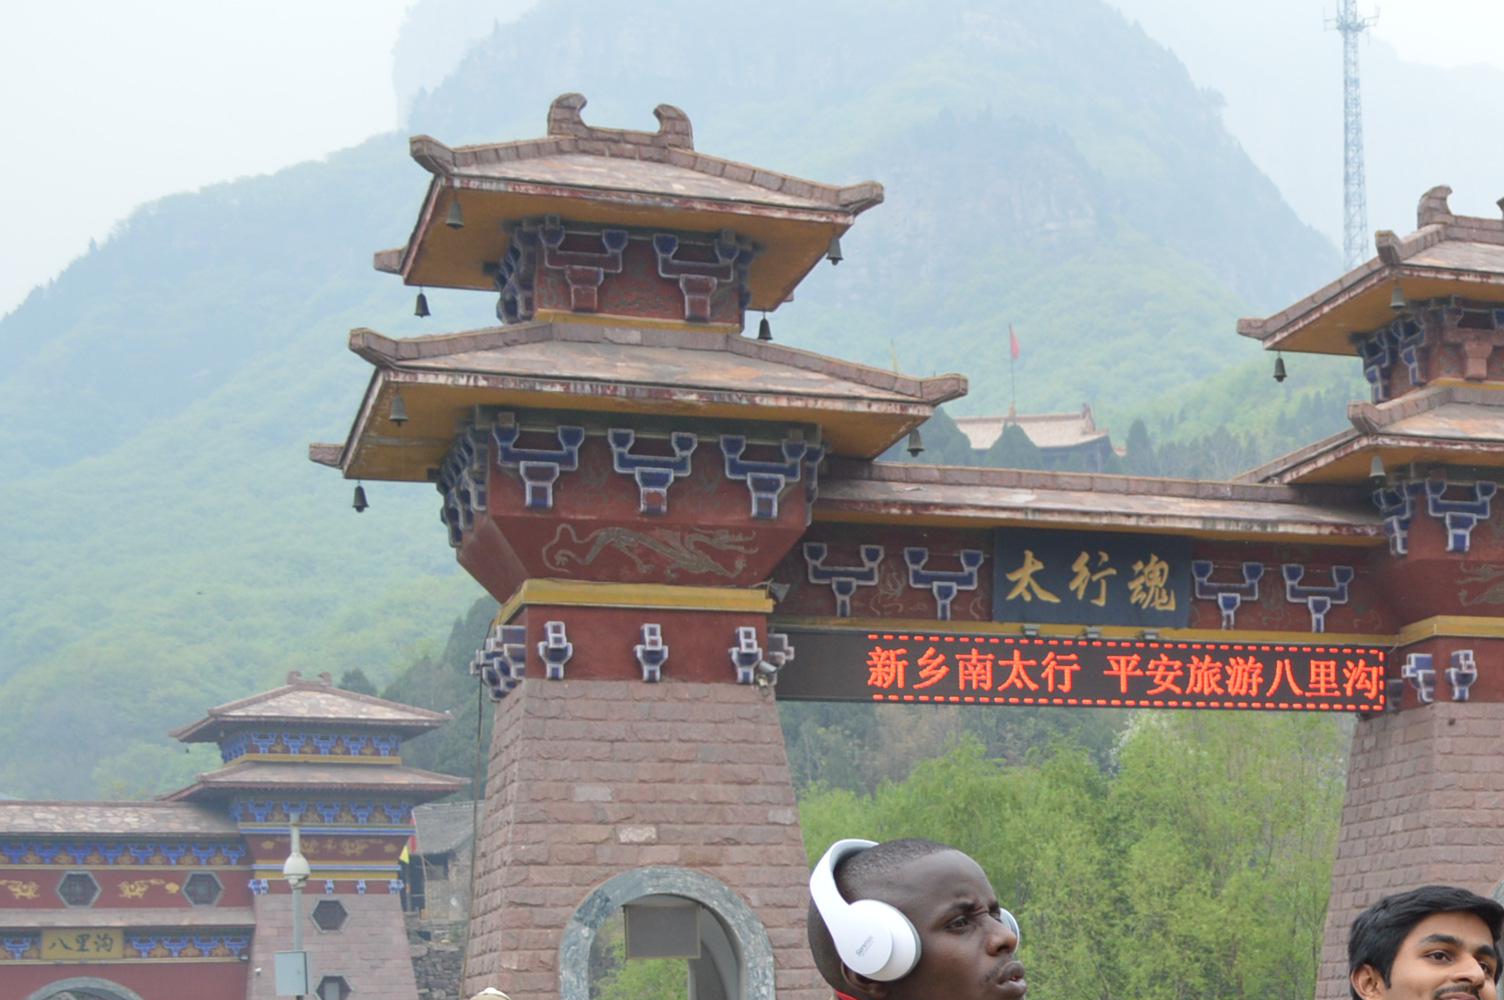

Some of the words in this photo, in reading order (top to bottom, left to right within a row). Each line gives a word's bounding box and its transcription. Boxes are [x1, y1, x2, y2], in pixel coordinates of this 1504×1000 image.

[1005, 550, 1177, 613] 太行魂
[866, 646, 1081, 694] 新乡南太行
[1103, 653, 1380, 700] 平安旅游八里沟
[48, 933, 114, 953] 八里沟
